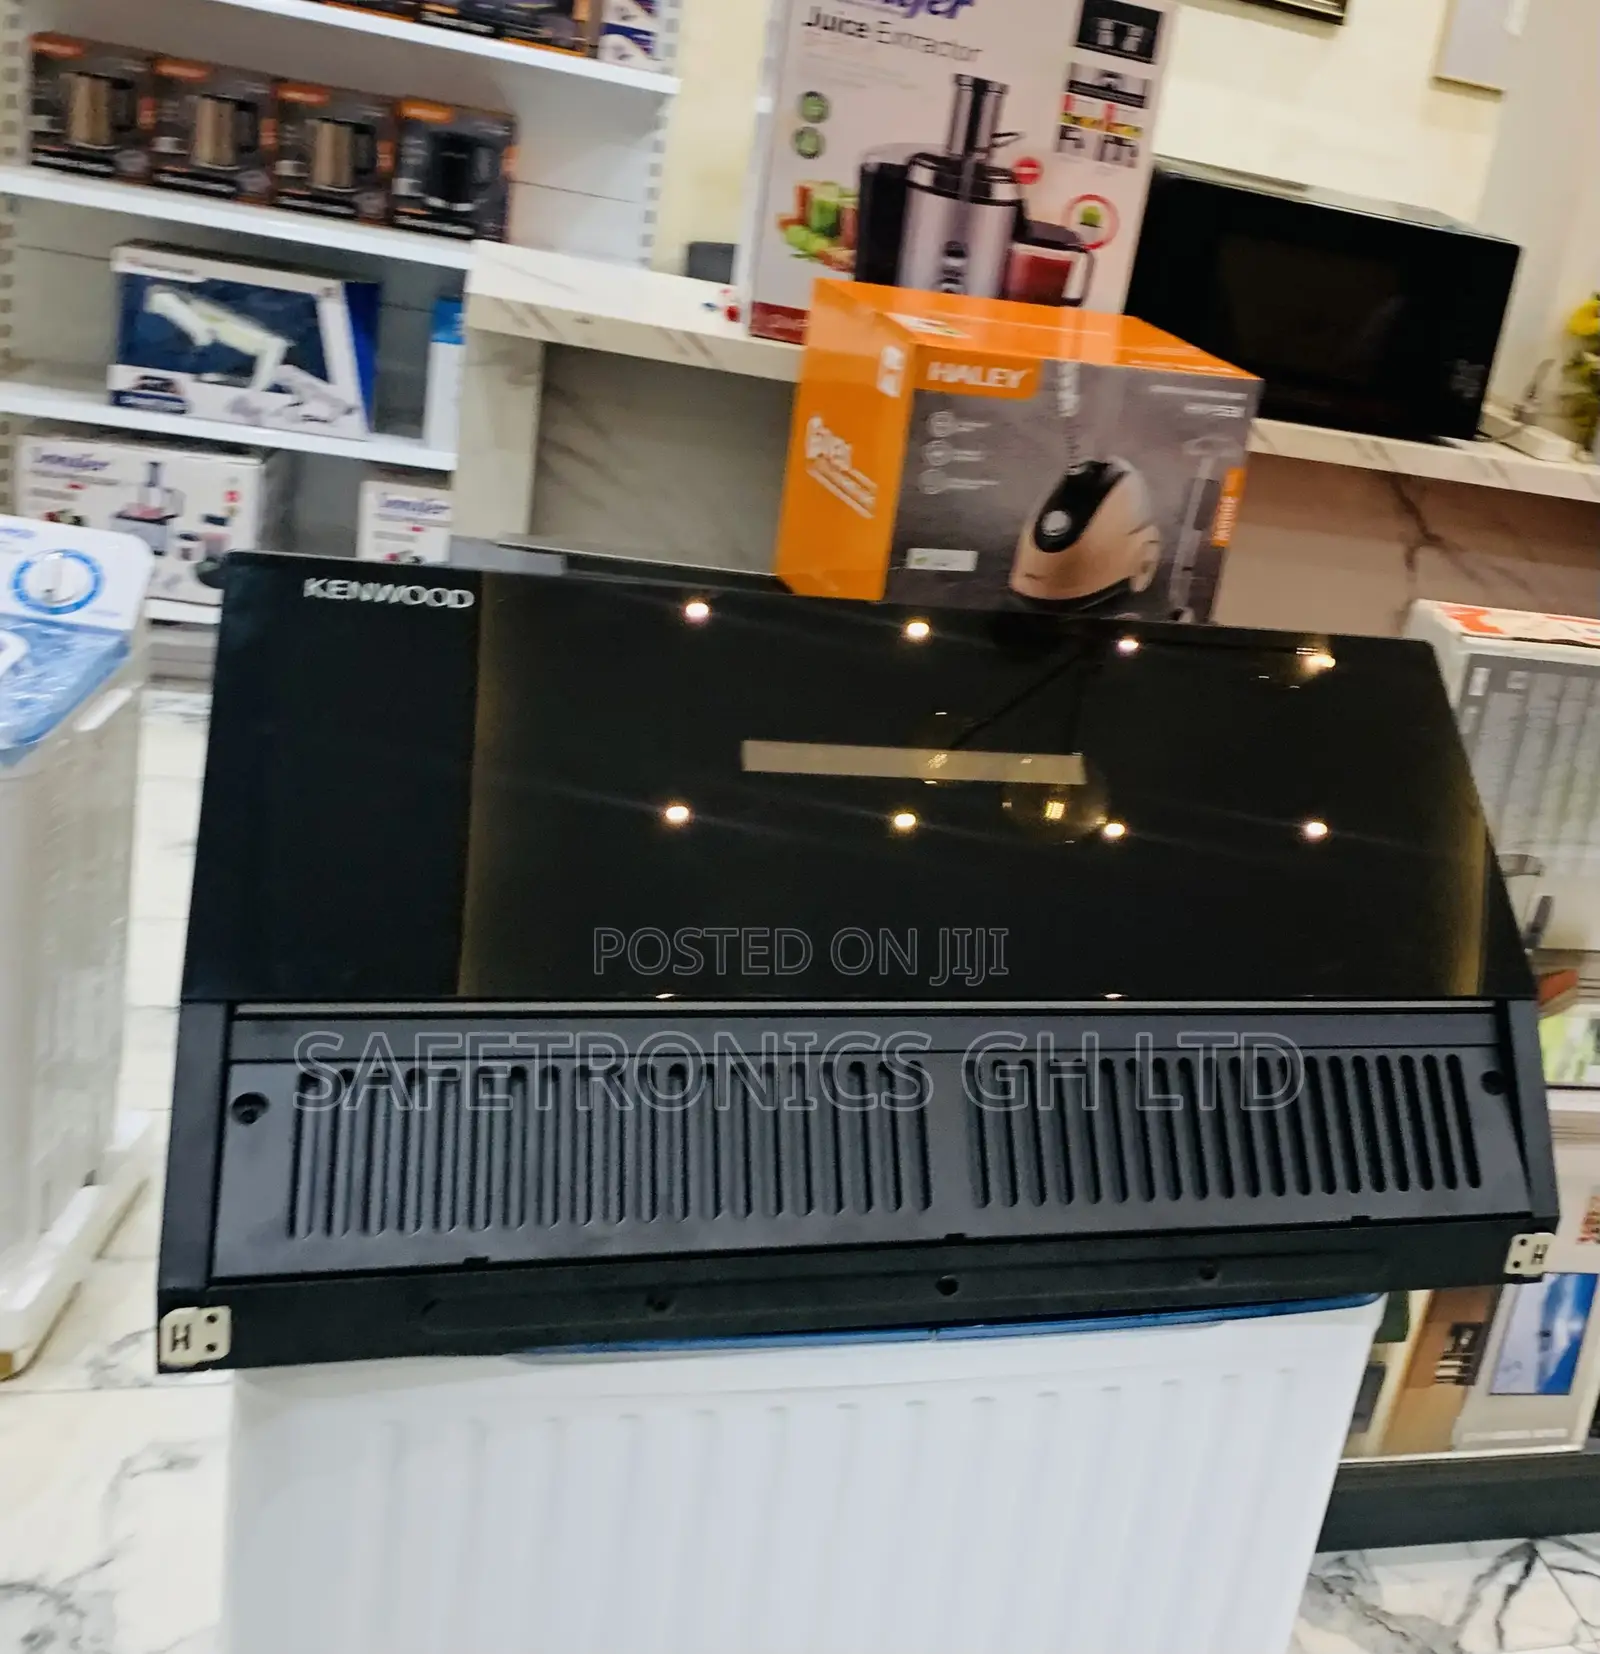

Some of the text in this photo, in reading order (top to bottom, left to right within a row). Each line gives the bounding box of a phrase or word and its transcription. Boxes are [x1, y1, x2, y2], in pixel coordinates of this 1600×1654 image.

[801, 6, 869, 38] Juice
[926, 361, 1034, 389] HALEY
[303, 577, 475, 609] KENWOOD
[170, 1323, 192, 1353] H
